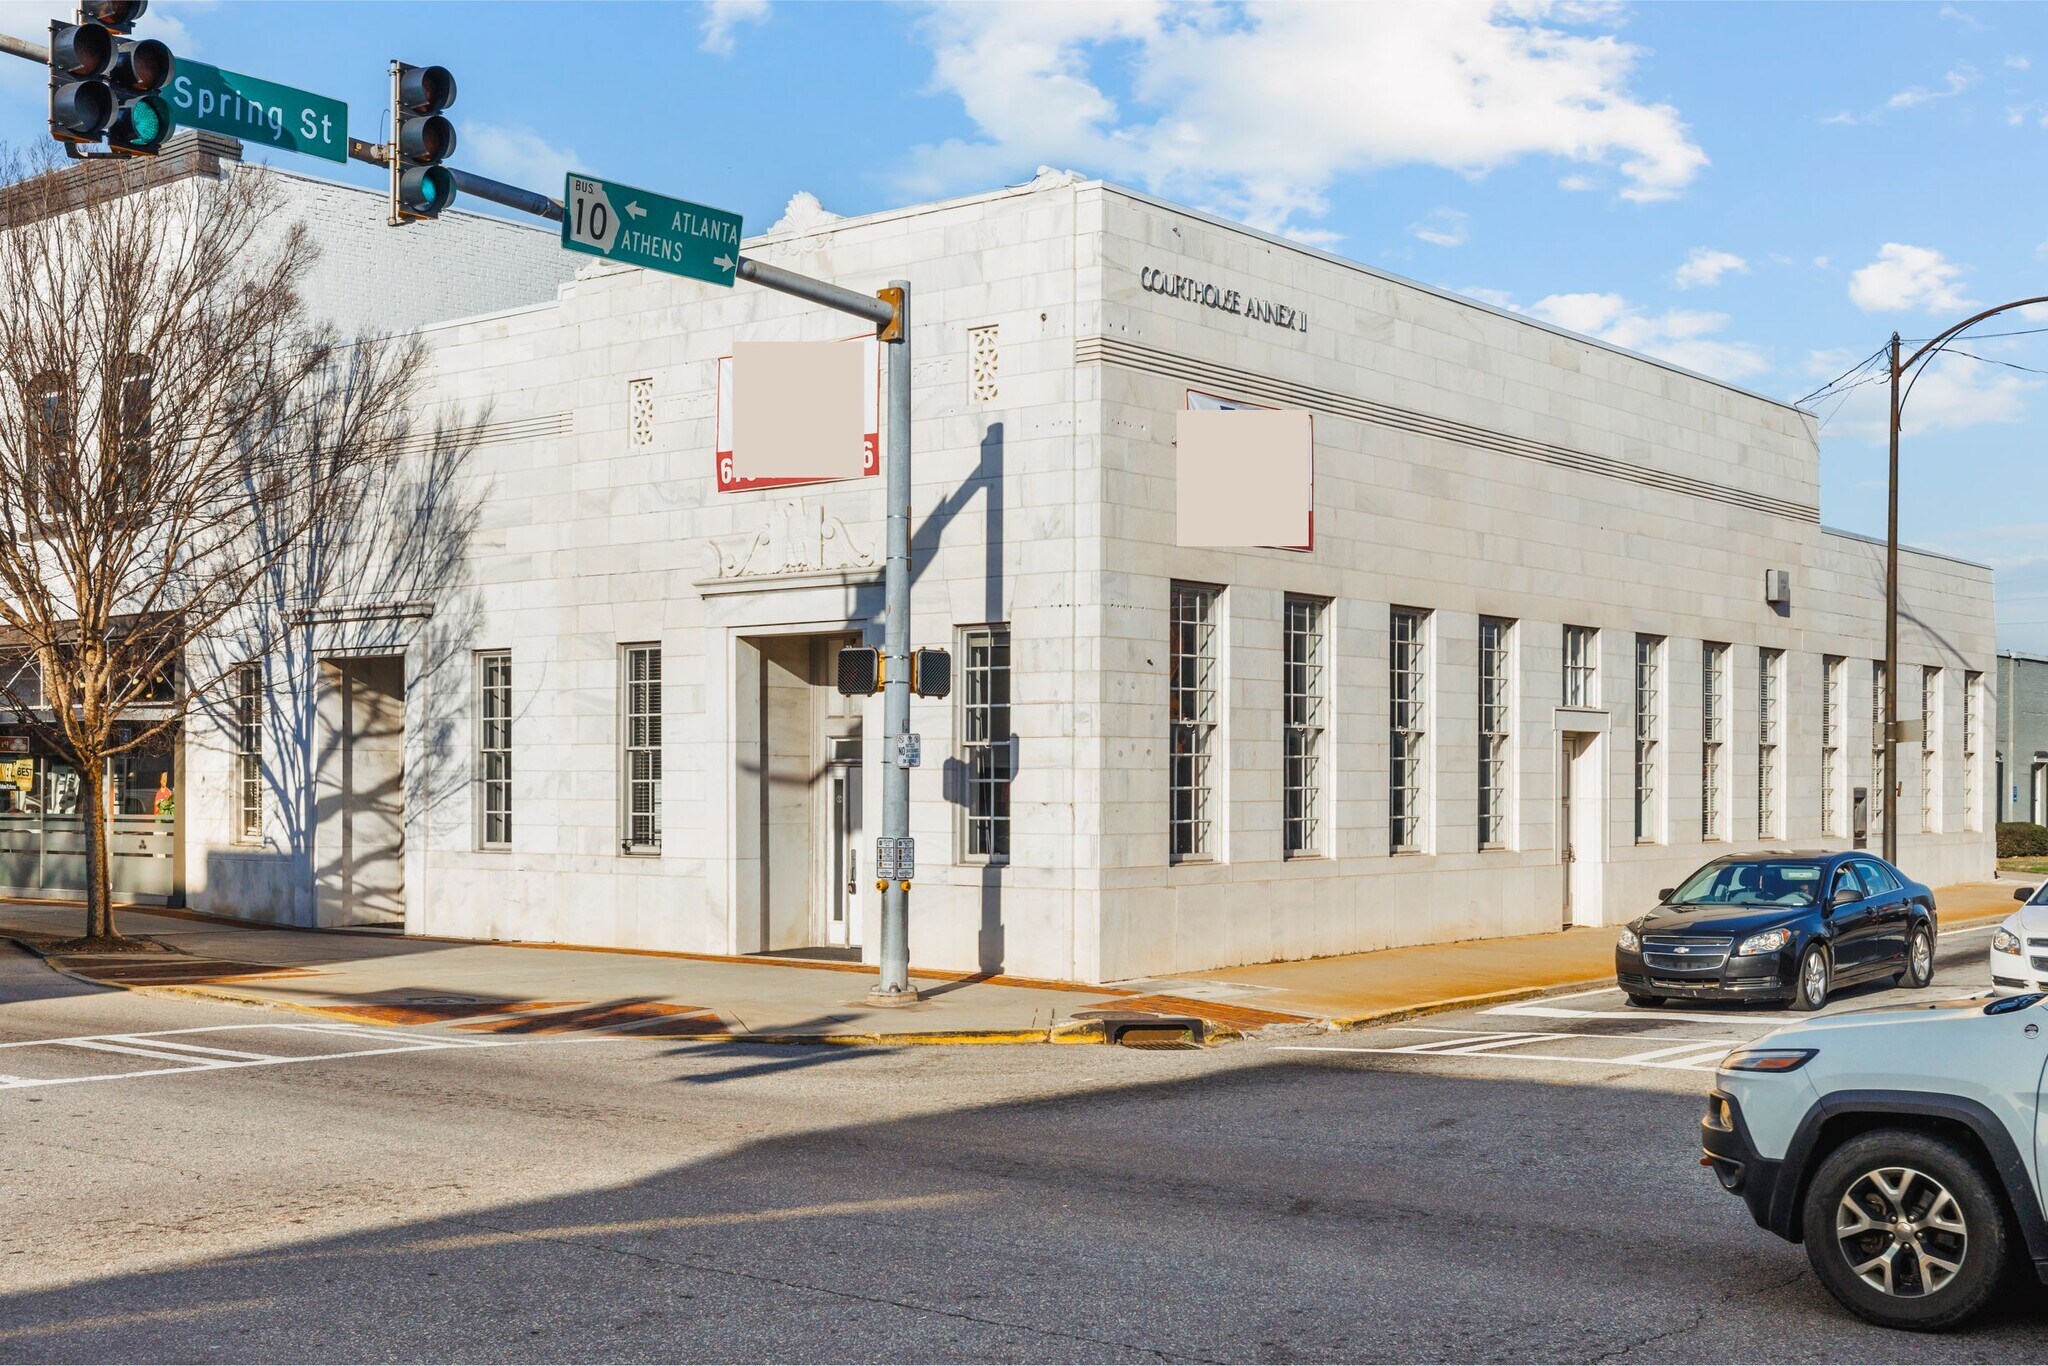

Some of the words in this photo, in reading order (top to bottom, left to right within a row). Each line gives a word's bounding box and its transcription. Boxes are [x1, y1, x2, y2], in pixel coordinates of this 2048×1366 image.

[173, 76, 283, 140] Spring
[300, 108, 332, 144] St
[576, 198, 607, 240] 10
[671, 211, 738, 245] ATLANTA
[621, 229, 683, 263] ATHENS
[1139, 266, 1241, 315] COURTHOUSE
[1244, 297, 1296, 331] ANNEX
[17, 767, 33, 777] BEST
